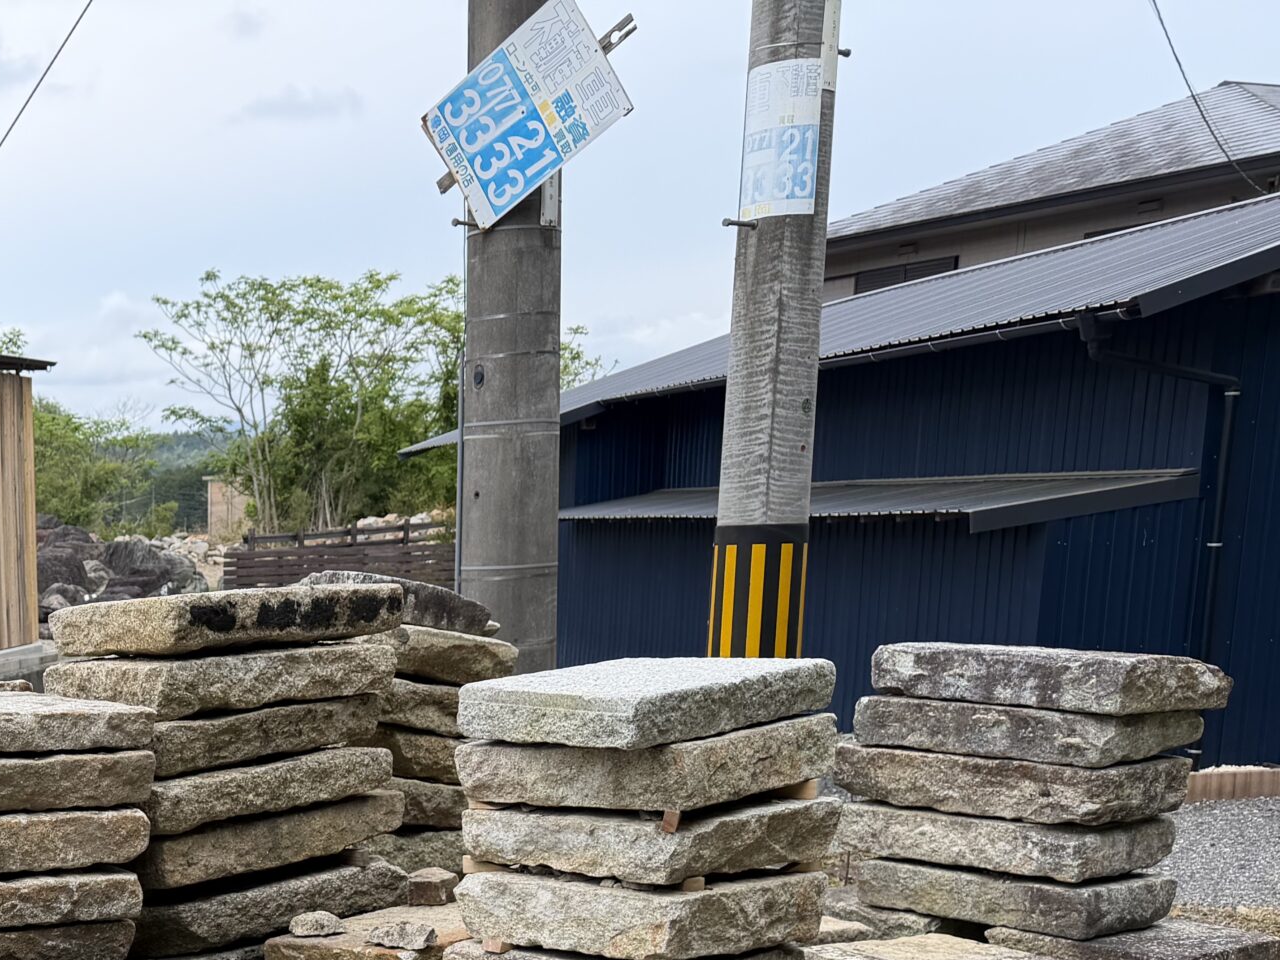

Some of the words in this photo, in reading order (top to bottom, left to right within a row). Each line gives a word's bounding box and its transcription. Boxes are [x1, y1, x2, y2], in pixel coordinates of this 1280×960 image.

[444, 89, 524, 206] 3333
[477, 65, 526, 123] 0771
[505, 120, 557, 178] 21
[550, 88, 592, 148] 融資
[779, 128, 815, 161] 21
